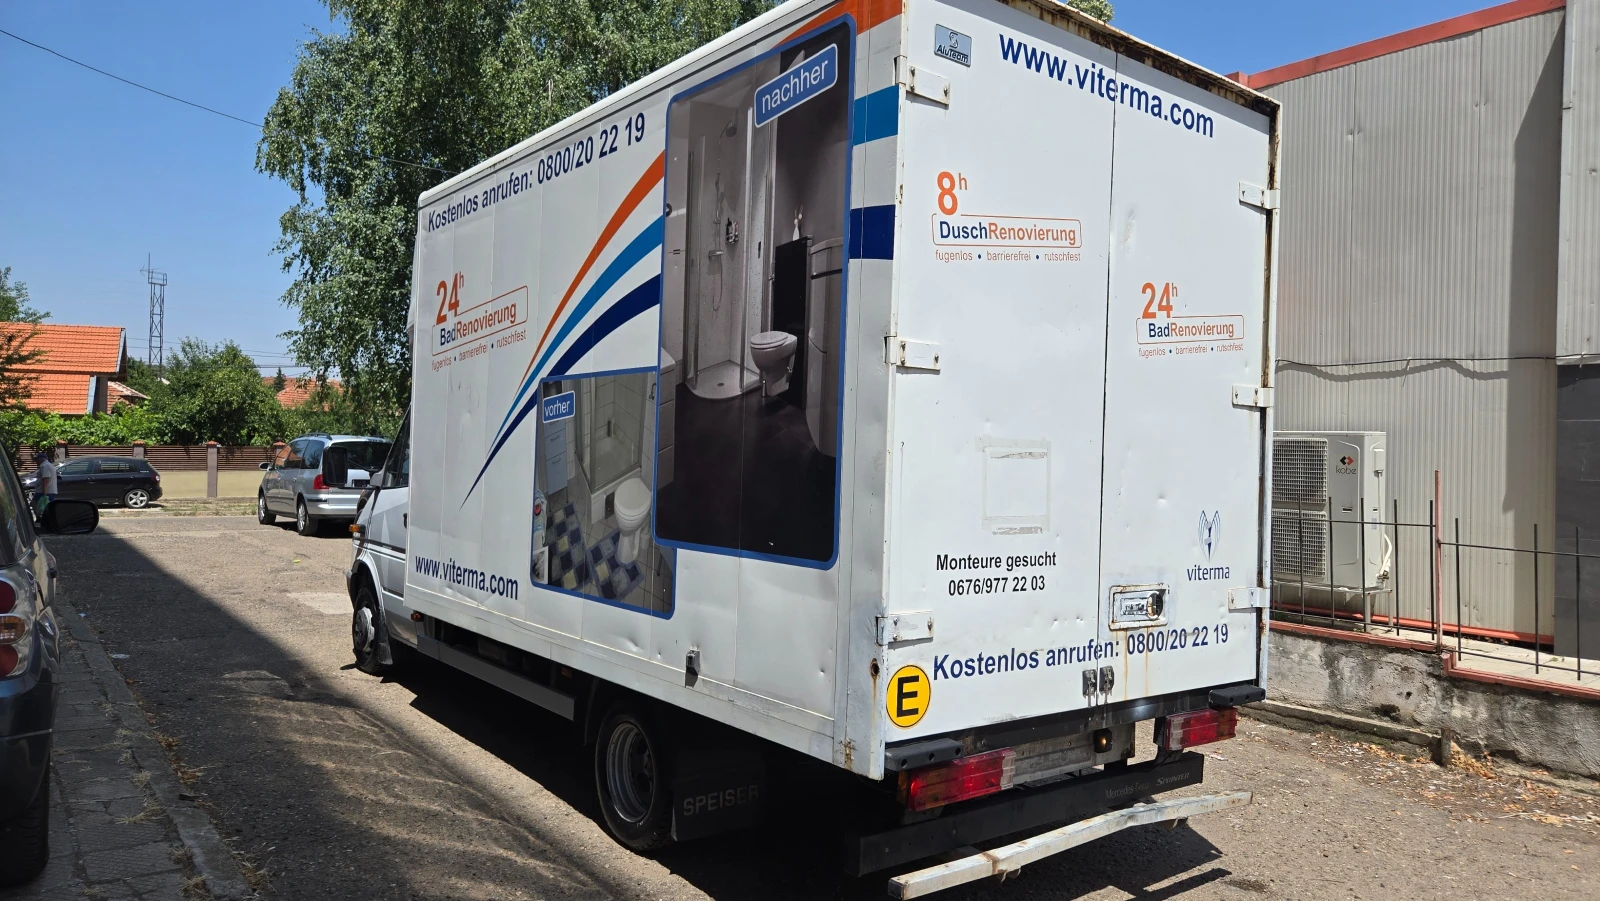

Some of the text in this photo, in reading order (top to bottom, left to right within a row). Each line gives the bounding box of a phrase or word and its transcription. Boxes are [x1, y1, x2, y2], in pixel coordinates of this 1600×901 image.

[936, 44, 969, 63] AluTeam
[762, 60, 829, 114] nachher
[998, 33, 1214, 138] www.viterma.com
[428, 112, 646, 233] Kostenlos anrufen: 0800/20 22 19
[939, 220, 1076, 246] DuschRenovierung
[935, 250, 1081, 264] fugenlos barrierefrei rutschfest
[440, 303, 517, 346] BadRenovierung
[1148, 321, 1235, 338] BadRenovierung
[496, 328, 527, 349] rutschfest
[1138, 342, 1244, 359] fugenlos barrierefrei rutschfest
[544, 399, 570, 418] vorher
[936, 551, 1057, 572] Monteure gesucht
[1186, 564, 1230, 581] viterma
[415, 555, 518, 600] www.viterma.com
[948, 575, 1046, 596] 0676/977 22 03
[933, 623, 1229, 681] Kostenlos anrufen: 0800/20 22 19
[896, 675, 920, 718] E
[683, 784, 759, 816] SPEISER
